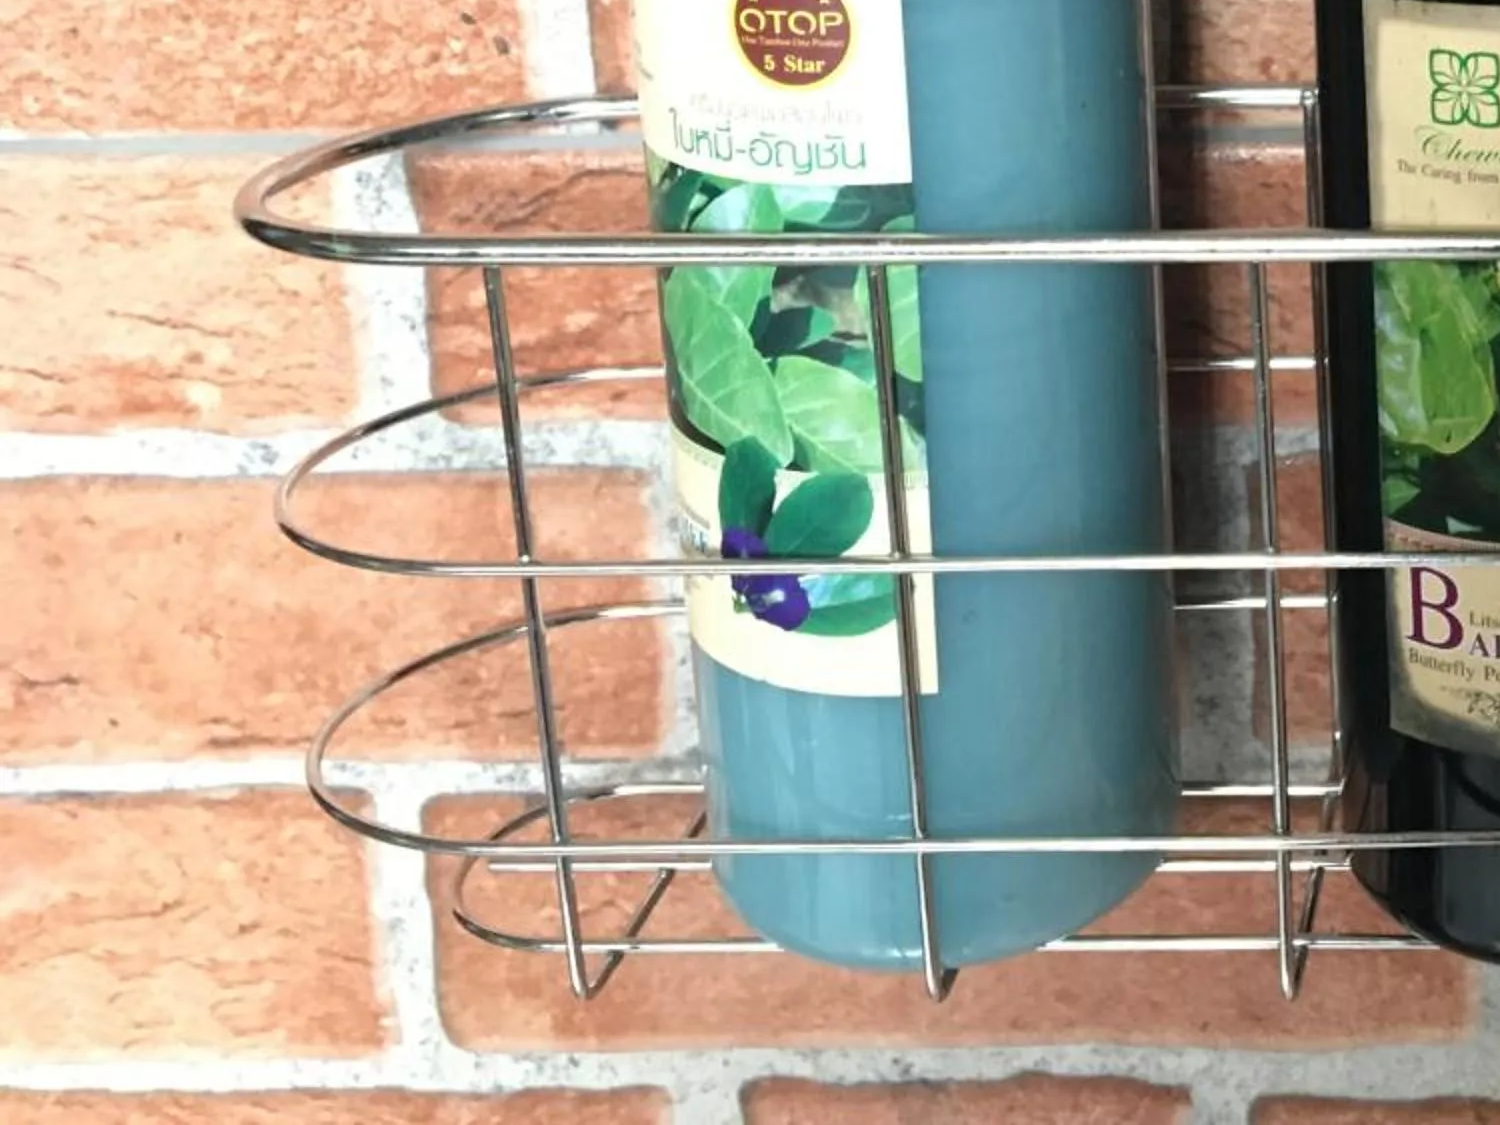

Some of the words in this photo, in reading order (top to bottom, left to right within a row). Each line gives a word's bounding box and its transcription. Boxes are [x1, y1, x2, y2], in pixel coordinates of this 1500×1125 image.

[739, 8, 844, 36] OTOP
[763, 53, 776, 71] 5
[783, 53, 826, 73] Star
[1408, 647, 1475, 680] Butterfly
